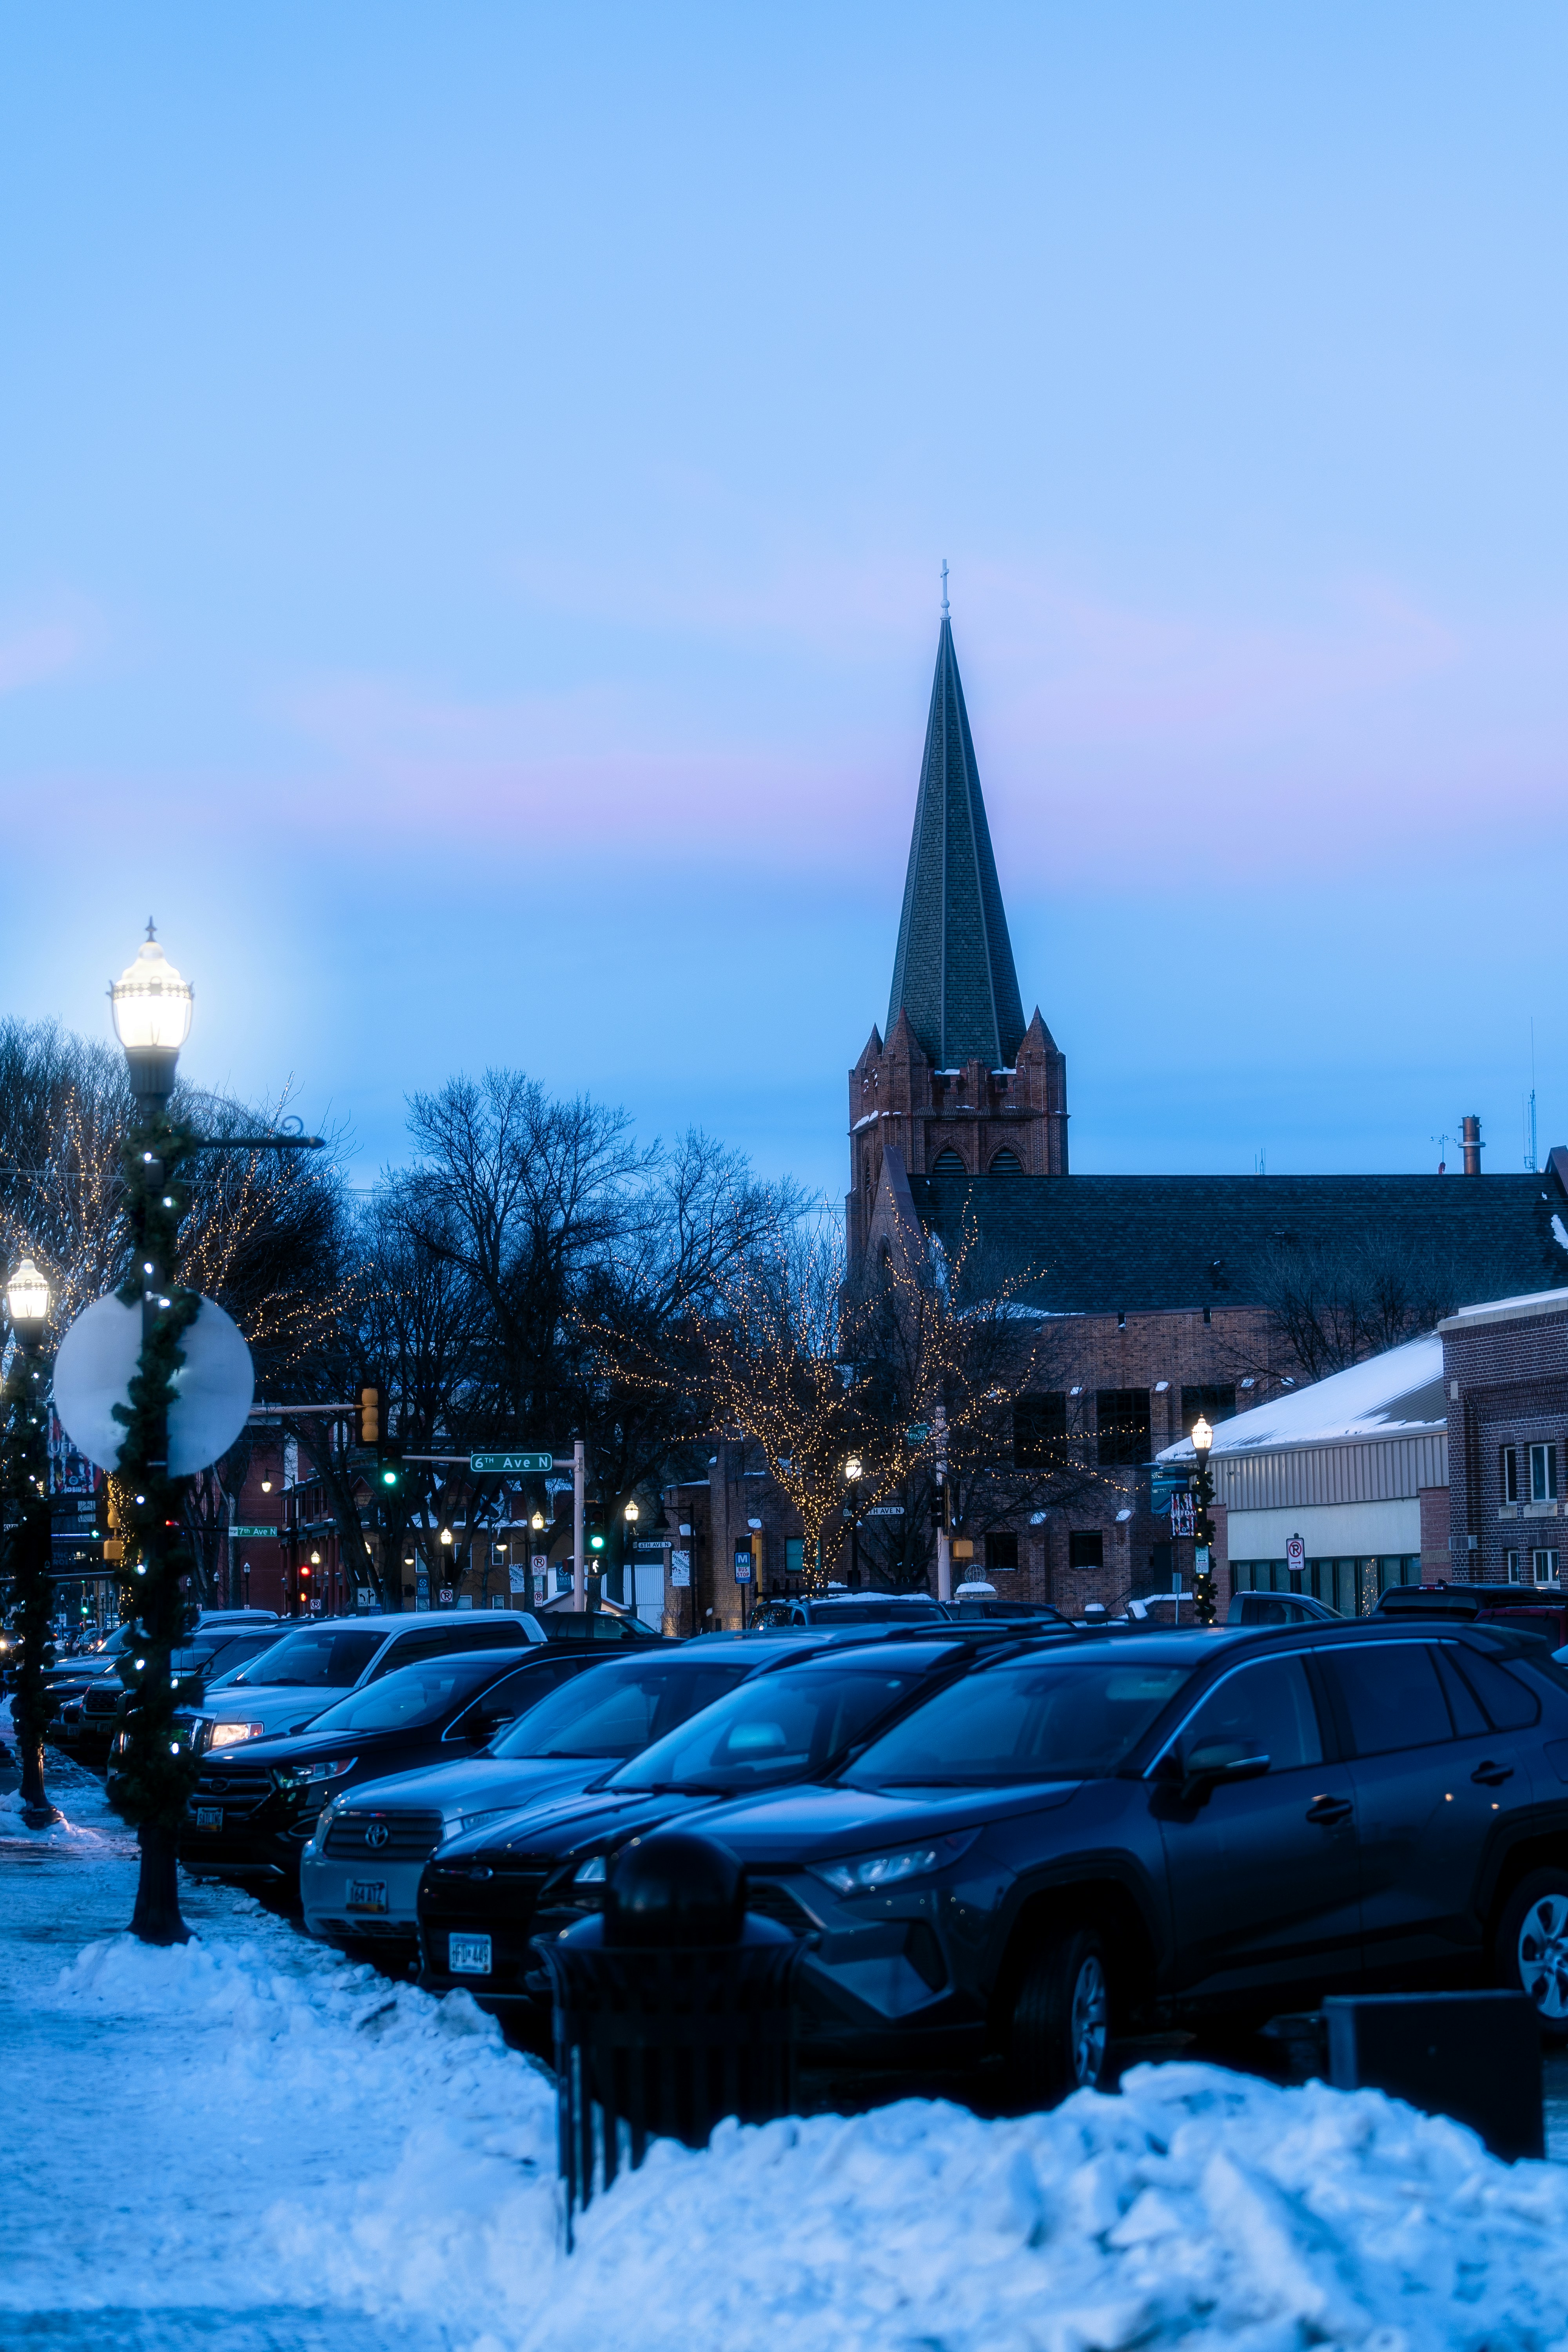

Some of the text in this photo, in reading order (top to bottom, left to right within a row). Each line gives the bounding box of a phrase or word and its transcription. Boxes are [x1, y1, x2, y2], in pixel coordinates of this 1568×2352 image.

[475, 1457, 547, 1468] 6TH Ave N
[672, 1553, 689, 1568] WORSHIP
[675, 1560, 683, 1568] WITH
[738, 1555, 748, 1563] M
[509, 1567, 524, 1578] WORSHIP
[199, 1813, 221, 1824] SAILING
